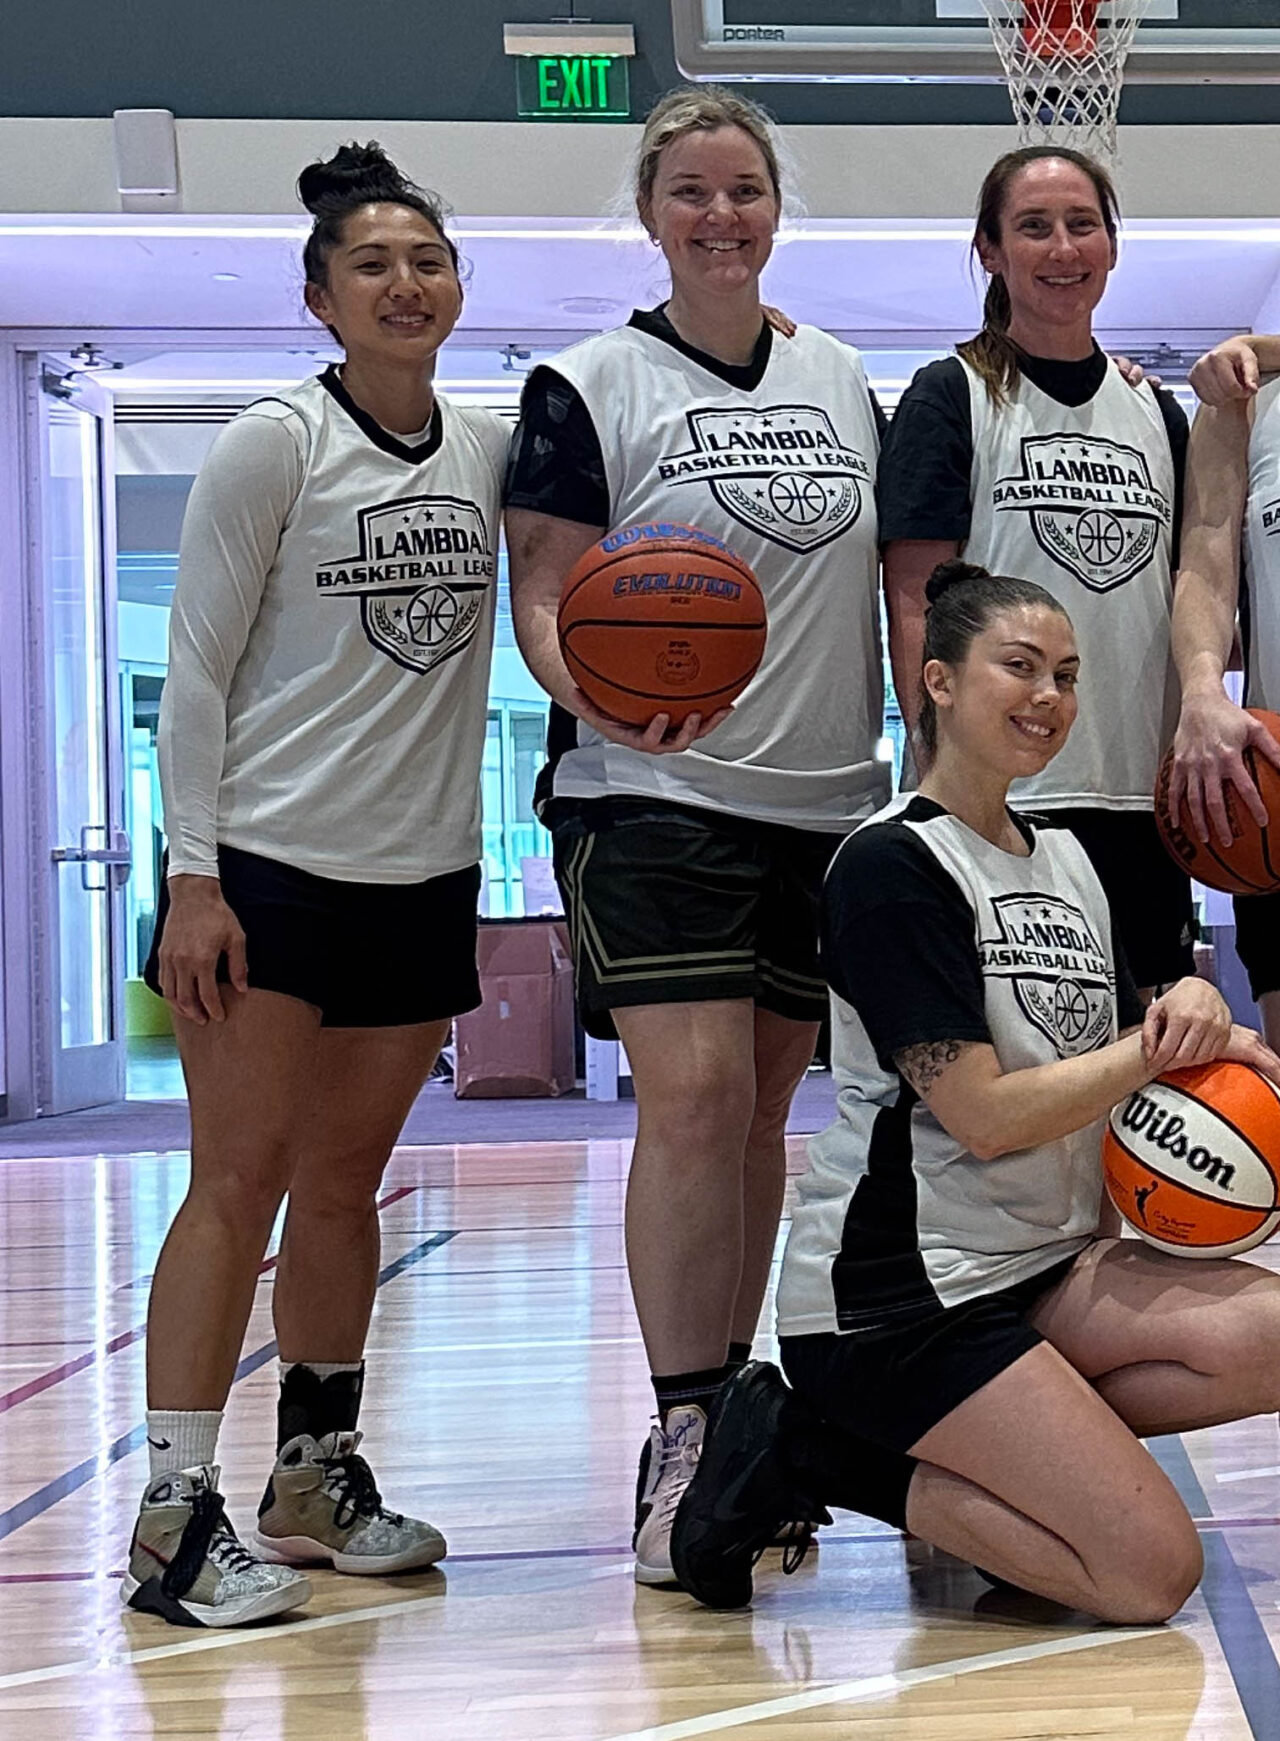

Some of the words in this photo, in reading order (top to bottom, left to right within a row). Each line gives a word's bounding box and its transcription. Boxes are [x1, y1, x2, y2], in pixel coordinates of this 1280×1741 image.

[539, 59, 611, 108] EXIT
[707, 429, 833, 451] LAMBDA
[658, 453, 811, 480] BASKETBALL
[1035, 460, 1147, 489] LAMBDA
[993, 485, 1118, 504] BASKETBALL
[375, 528, 482, 560] LAMBDA
[316, 560, 457, 587] BASKETBALL
[1009, 923, 1098, 956] LAMBDA
[1121, 1091, 1236, 1191] Wilson
